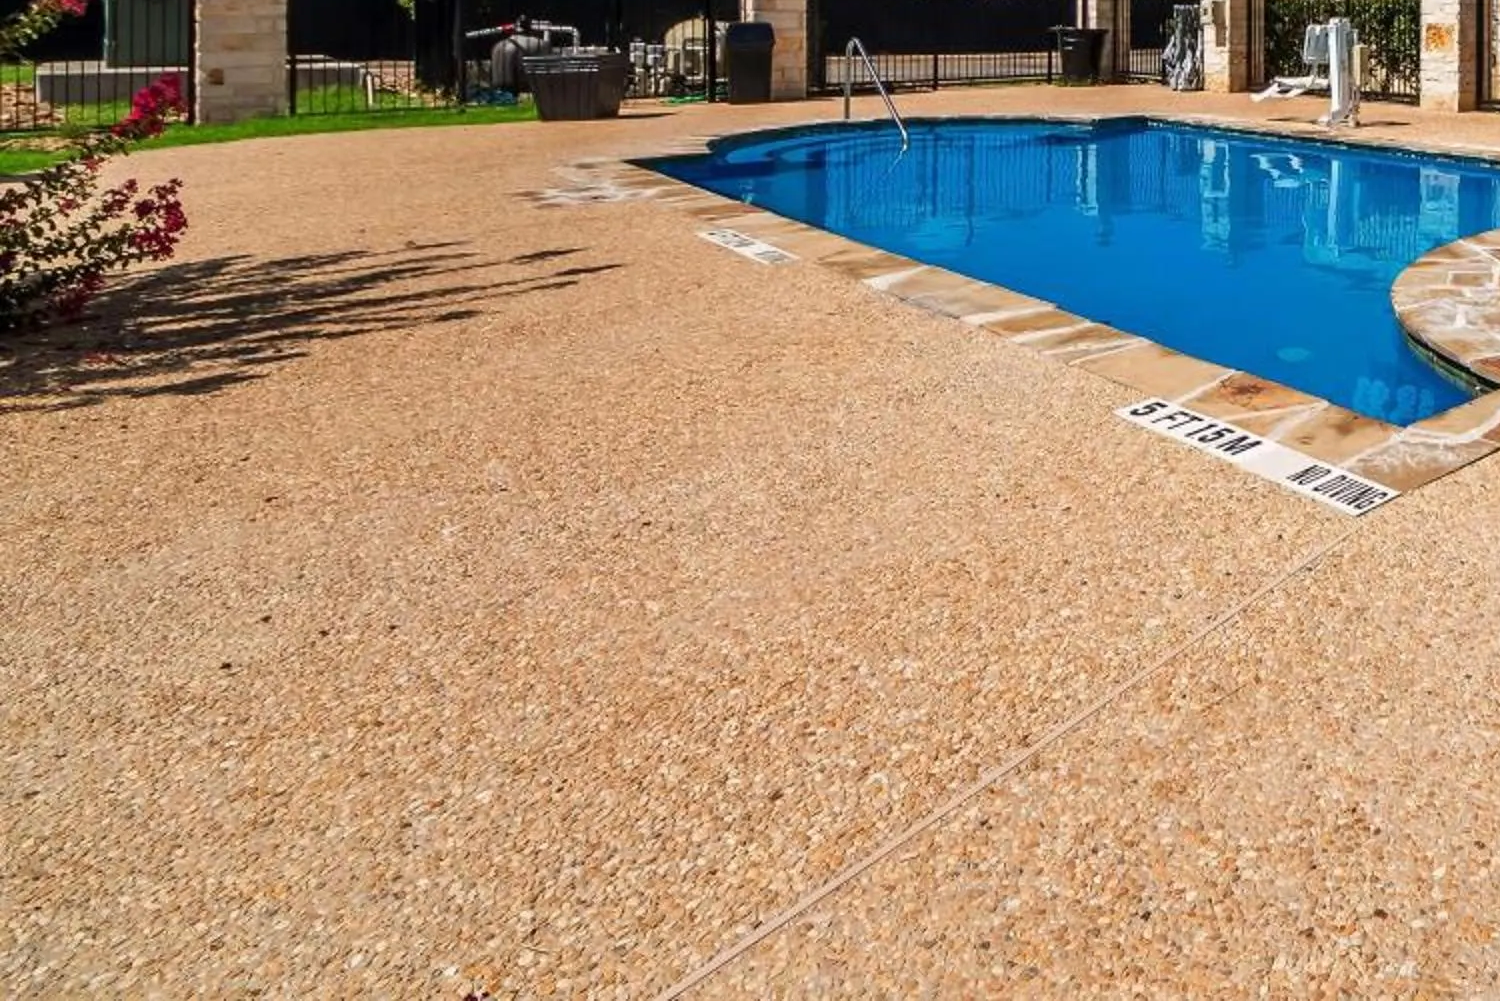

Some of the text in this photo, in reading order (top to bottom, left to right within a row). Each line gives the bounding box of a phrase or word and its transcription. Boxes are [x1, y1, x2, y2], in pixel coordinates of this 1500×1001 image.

[1130, 402, 1169, 416] 5
[1152, 410, 1204, 431] FT
[1214, 435, 1263, 456] M
[1286, 464, 1389, 510] NO DIVING
